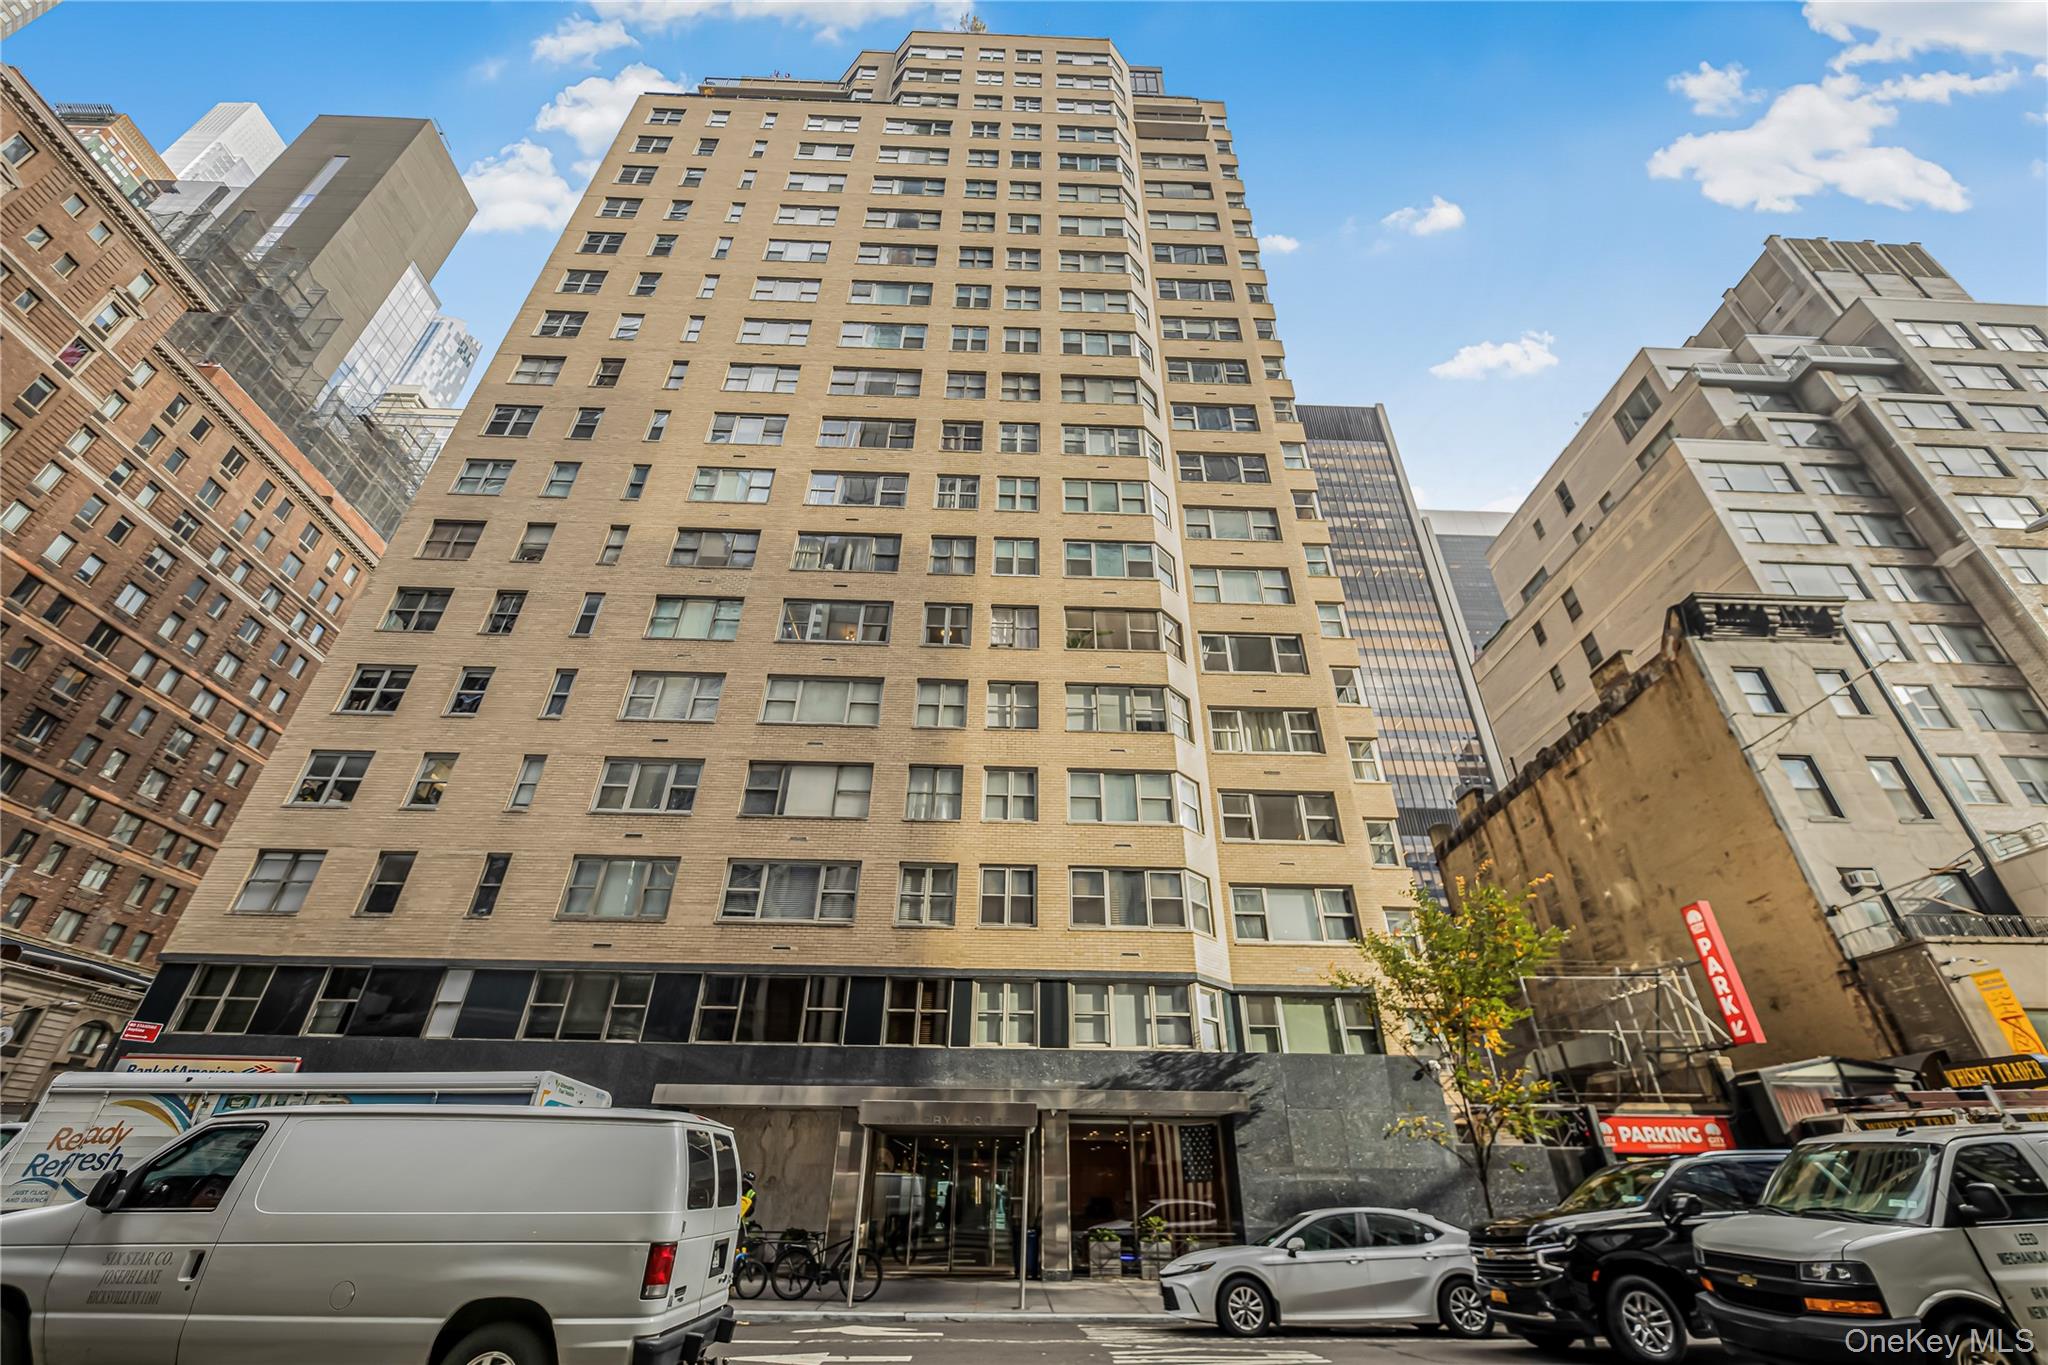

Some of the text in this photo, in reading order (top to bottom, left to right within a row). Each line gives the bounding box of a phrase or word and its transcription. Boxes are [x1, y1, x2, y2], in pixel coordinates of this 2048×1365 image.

[1696, 936, 1740, 1016] PARK
[1943, 1060, 2046, 1088] WHISKEY TRADER
[47, 1120, 133, 1150] Ready
[1617, 1126, 1703, 1144] PARKING
[22, 1146, 124, 1178] Refresh
[2014, 1233, 2040, 1246] LEED
[121, 1251, 155, 1266] STAR
[154, 1251, 174, 1266] CO.
